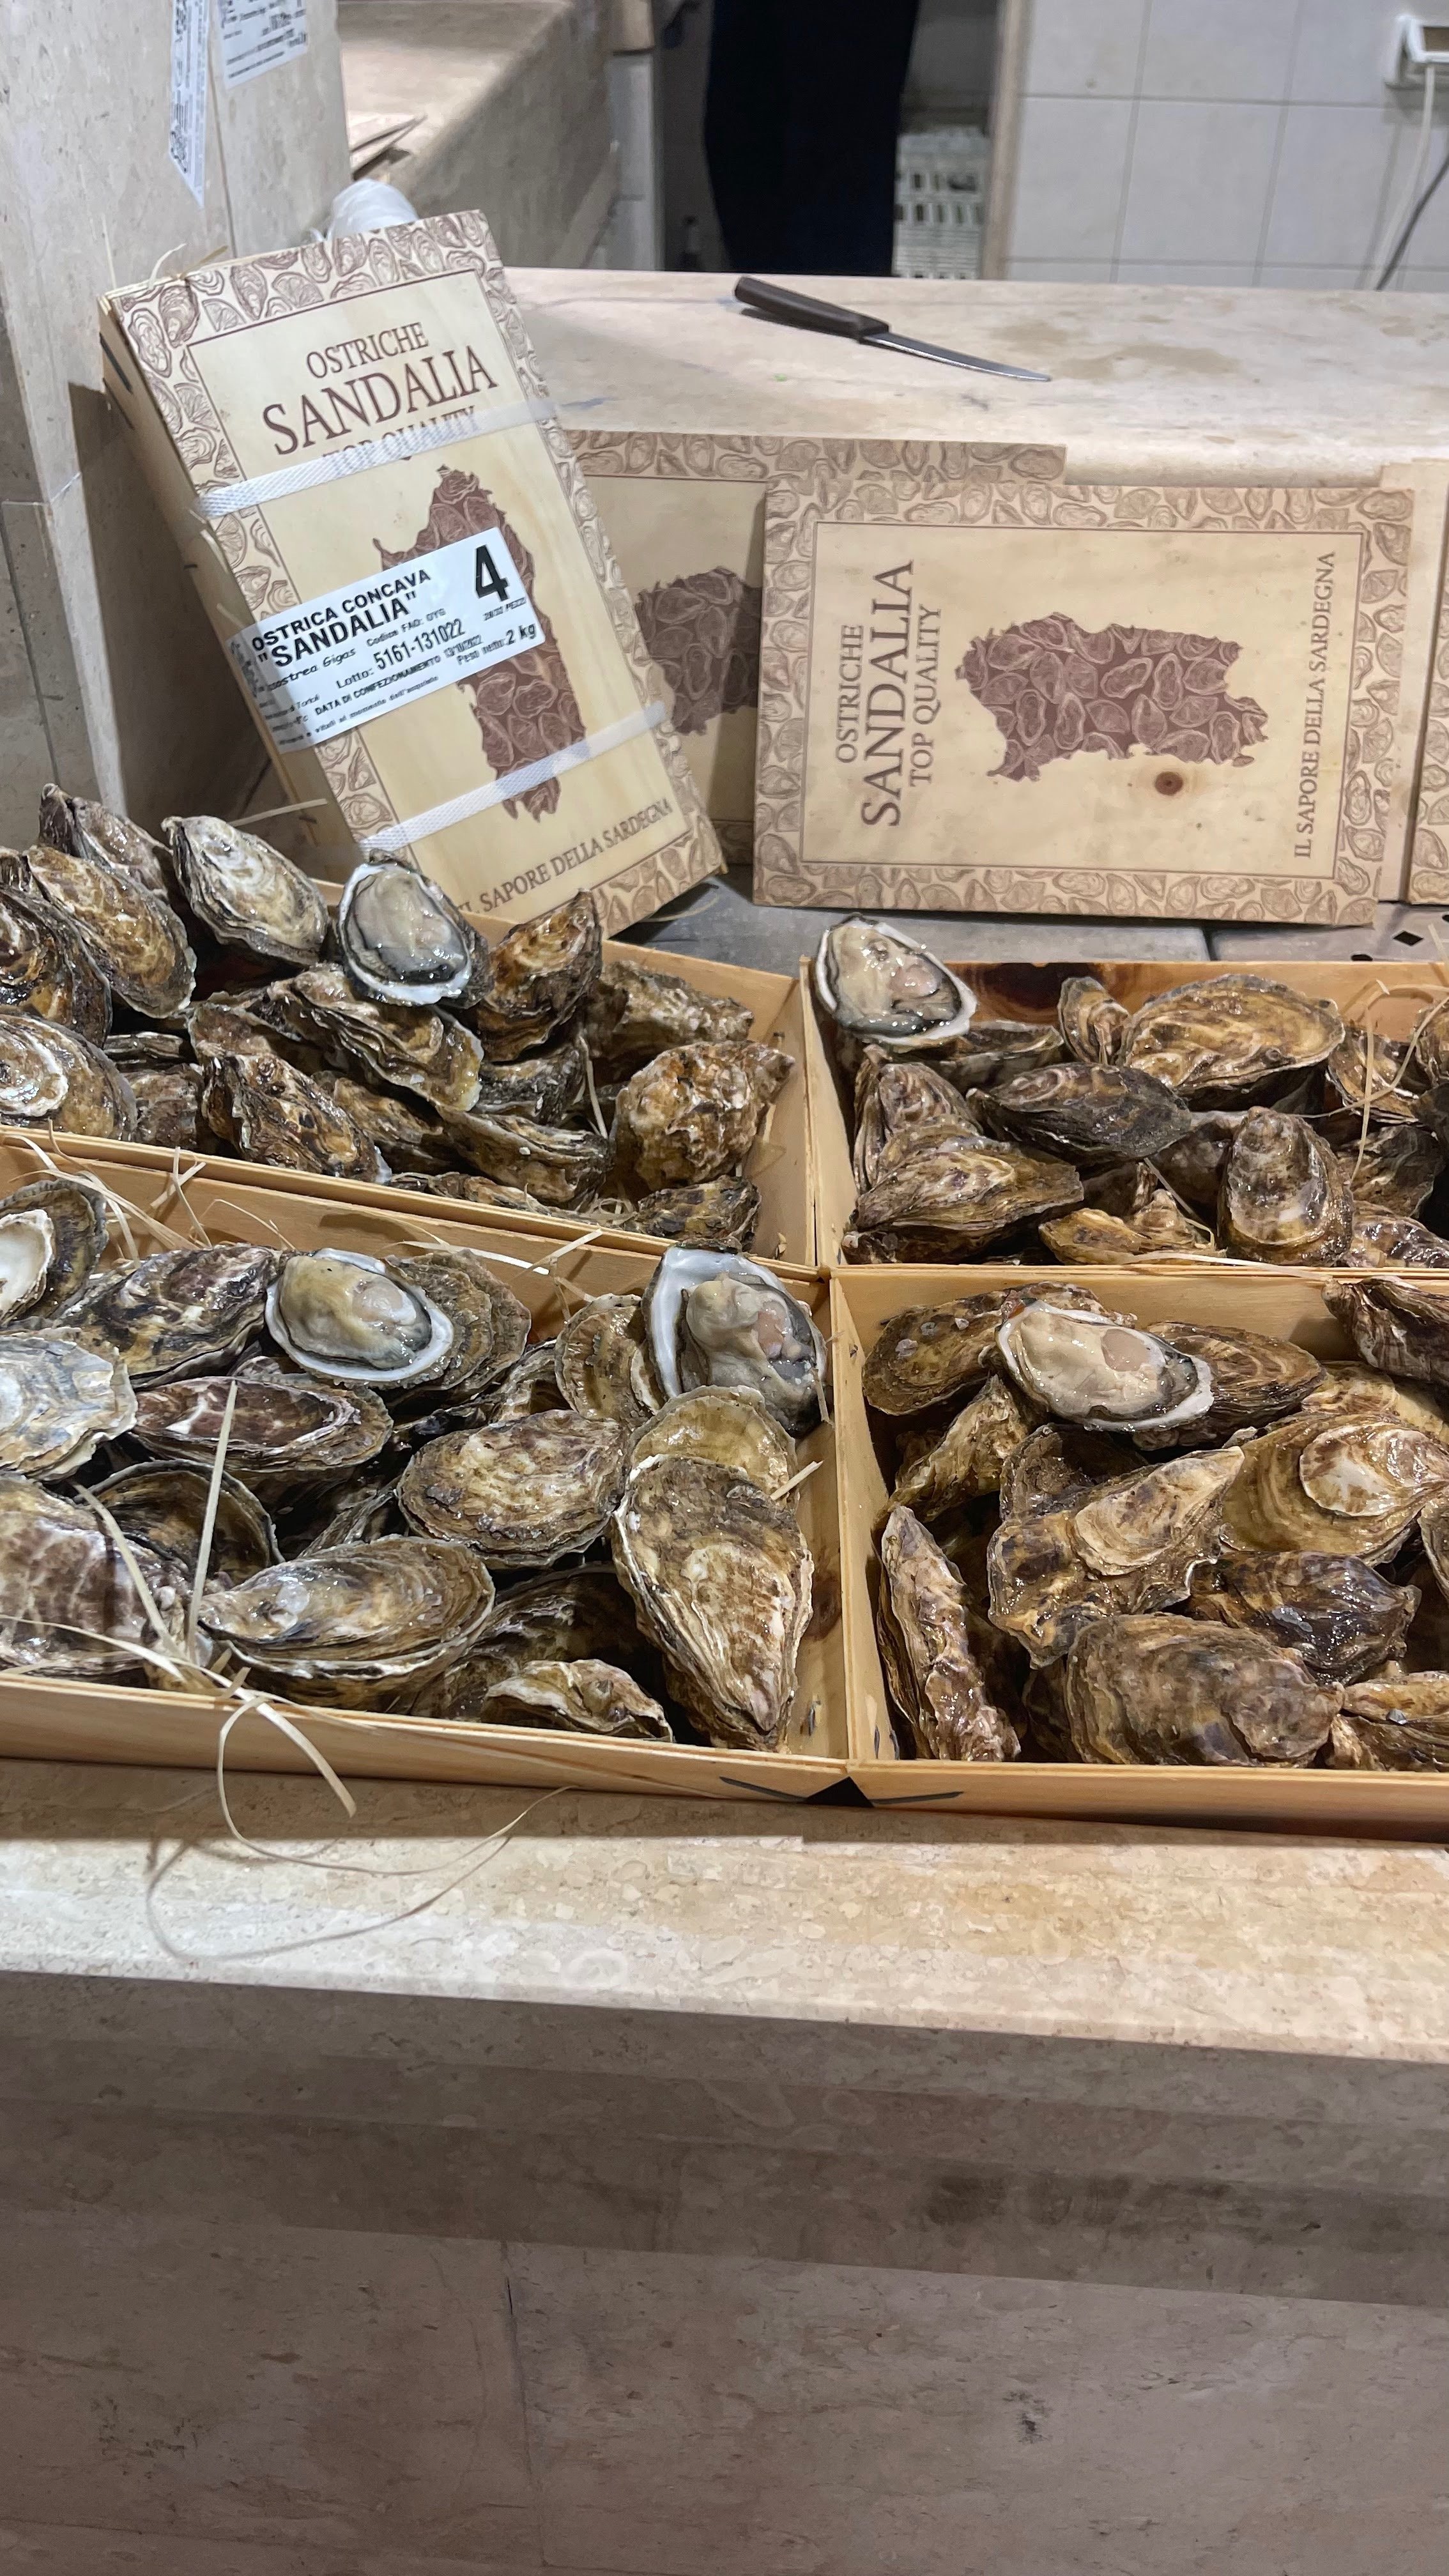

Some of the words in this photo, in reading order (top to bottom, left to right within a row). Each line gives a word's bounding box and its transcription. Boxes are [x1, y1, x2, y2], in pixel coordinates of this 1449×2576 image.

[307, 321, 429, 378] OSTRICHE
[263, 344, 498, 456] SANDALIA
[252, 608, 337, 651] OSTRICA
[342, 570, 431, 613] CONCAVA
[475, 545, 509, 601] 4
[257, 591, 416, 666] "SANDALIA"
[505, 629, 516, 645] 2
[518, 624, 537, 640] kg
[1309, 551, 1335, 673] SARDEGNA
[336, 668, 374, 688] Lotto:
[374, 618, 464, 670] 5161-131022
[912, 603, 941, 724] QUALITY
[315, 700, 341, 715] DATA
[836, 624, 864, 763] OSTRICHE
[860, 558, 915, 827] SANDALIA
[1304, 677, 1325, 746] DELLA
[908, 733, 934, 787] TOP
[1296, 750, 1320, 836] SAPORE
[480, 862, 552, 912] SAPORE
[553, 839, 604, 877] DELLA
[603, 798, 674, 849] SARDEGNA
[1294, 839, 1312, 859] IL
